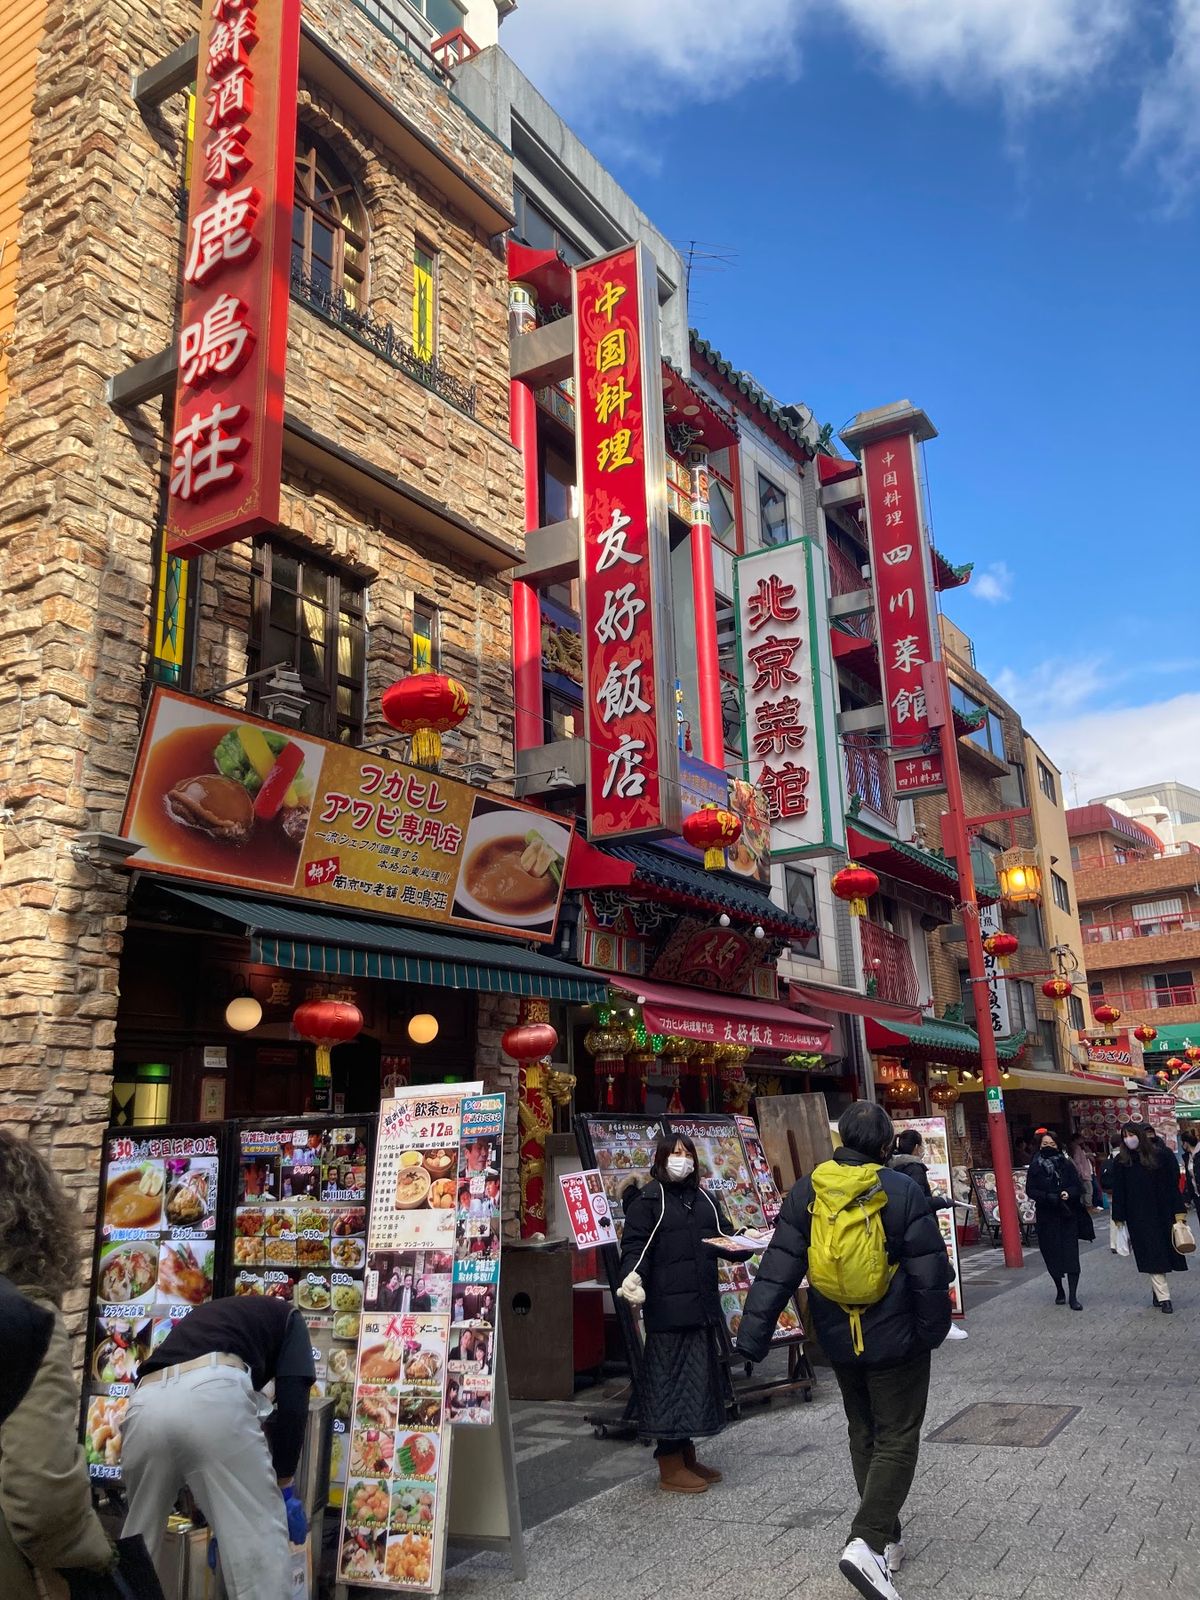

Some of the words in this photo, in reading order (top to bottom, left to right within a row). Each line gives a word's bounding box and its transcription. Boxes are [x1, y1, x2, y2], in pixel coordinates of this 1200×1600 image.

[170, 187, 253, 500] 鹿鳴荘
[594, 281, 636, 473] 中国料理
[881, 450, 903, 528] 中国料理
[882, 543, 929, 724] 四川菜館
[594, 508, 653, 799] 友好飯店
[747, 573, 810, 821] 北京菜館
[360, 763, 447, 812] フカヒレ
[898, 772, 943, 788] 四川料理
[320, 792, 462, 854] アワビ専門店
[315, 831, 420, 862] 一流シェフが調理する
[308, 859, 338, 883] 神戸
[332, 875, 400, 898] 南京町老舗
[400, 886, 449, 910] 鹿鳴荘
[724, 1021, 773, 1046] 友好飯店
[415, 1101, 461, 1117] 飲茶セット
[419, 1122, 453, 1138] 全12品
[577, 1230, 599, 1243] OK!
[384, 1316, 417, 1338] 人気
